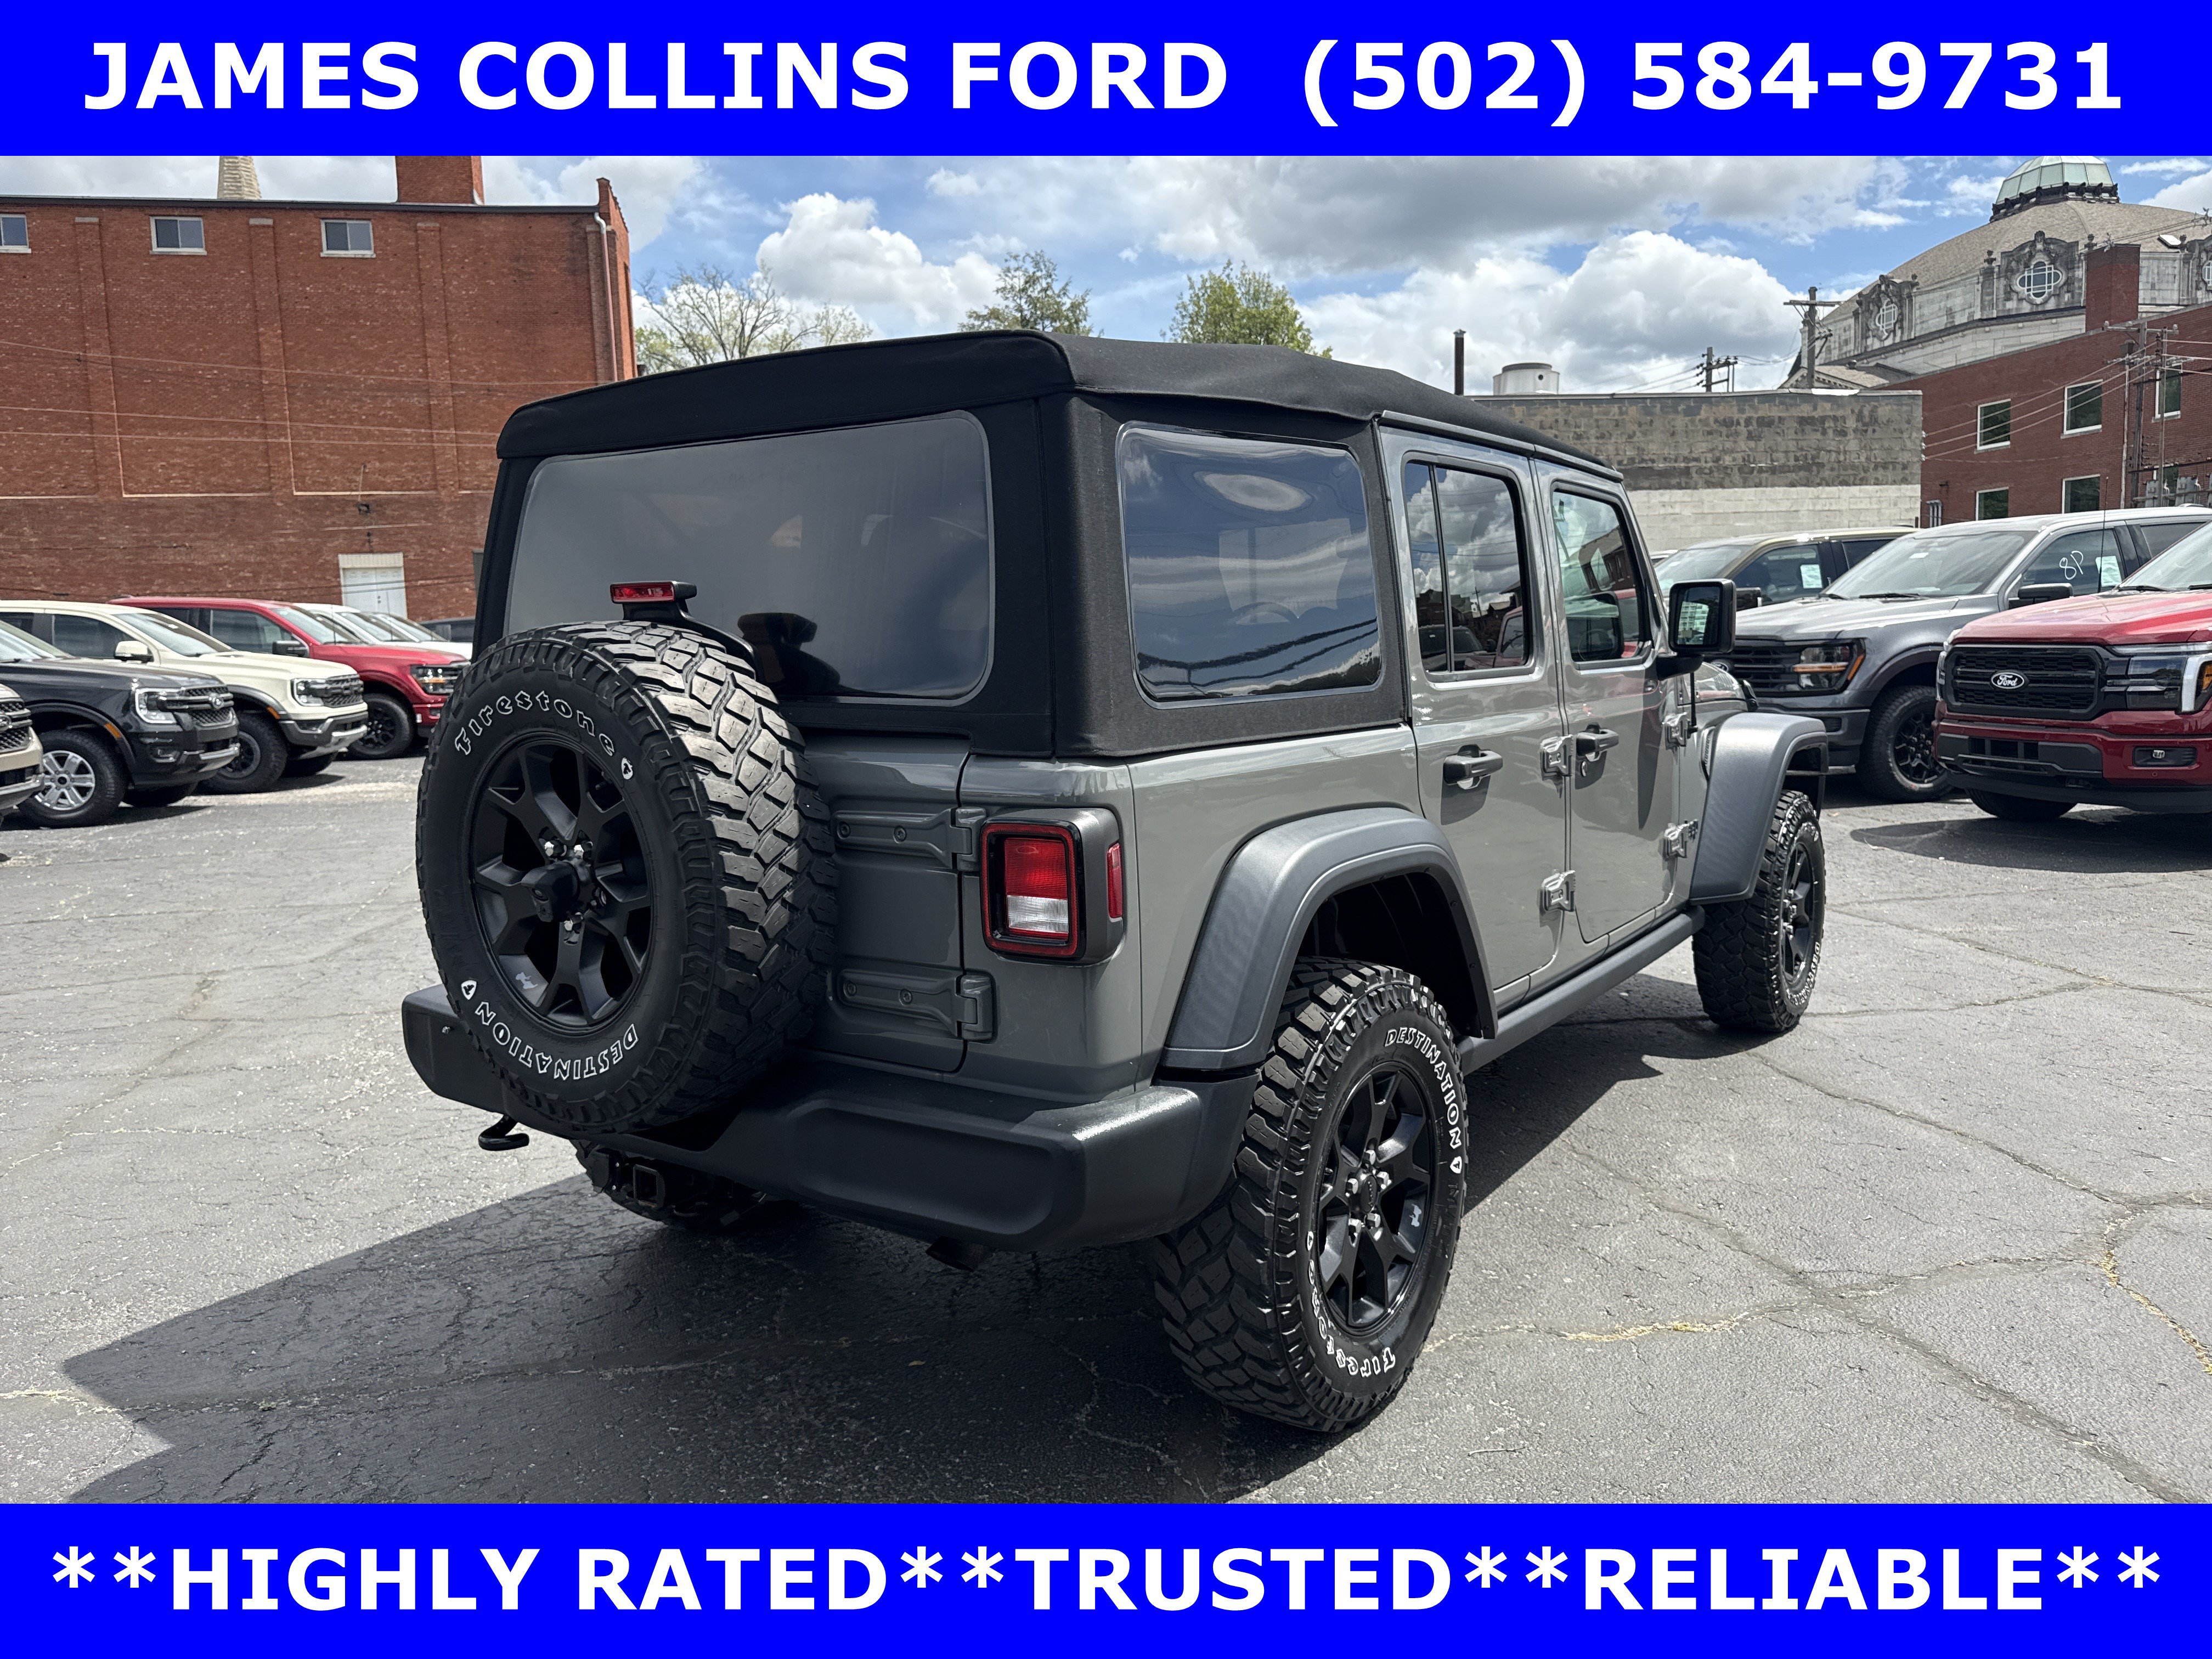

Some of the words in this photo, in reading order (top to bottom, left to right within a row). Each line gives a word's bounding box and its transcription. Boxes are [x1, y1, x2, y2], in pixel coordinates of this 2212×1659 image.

[1997, 674, 2018, 686] Ford
[455, 690, 615, 756] Firestone
[475, 1001, 639, 1080] DESTINATION
[1384, 1027, 1462, 1149] DESTINATION
